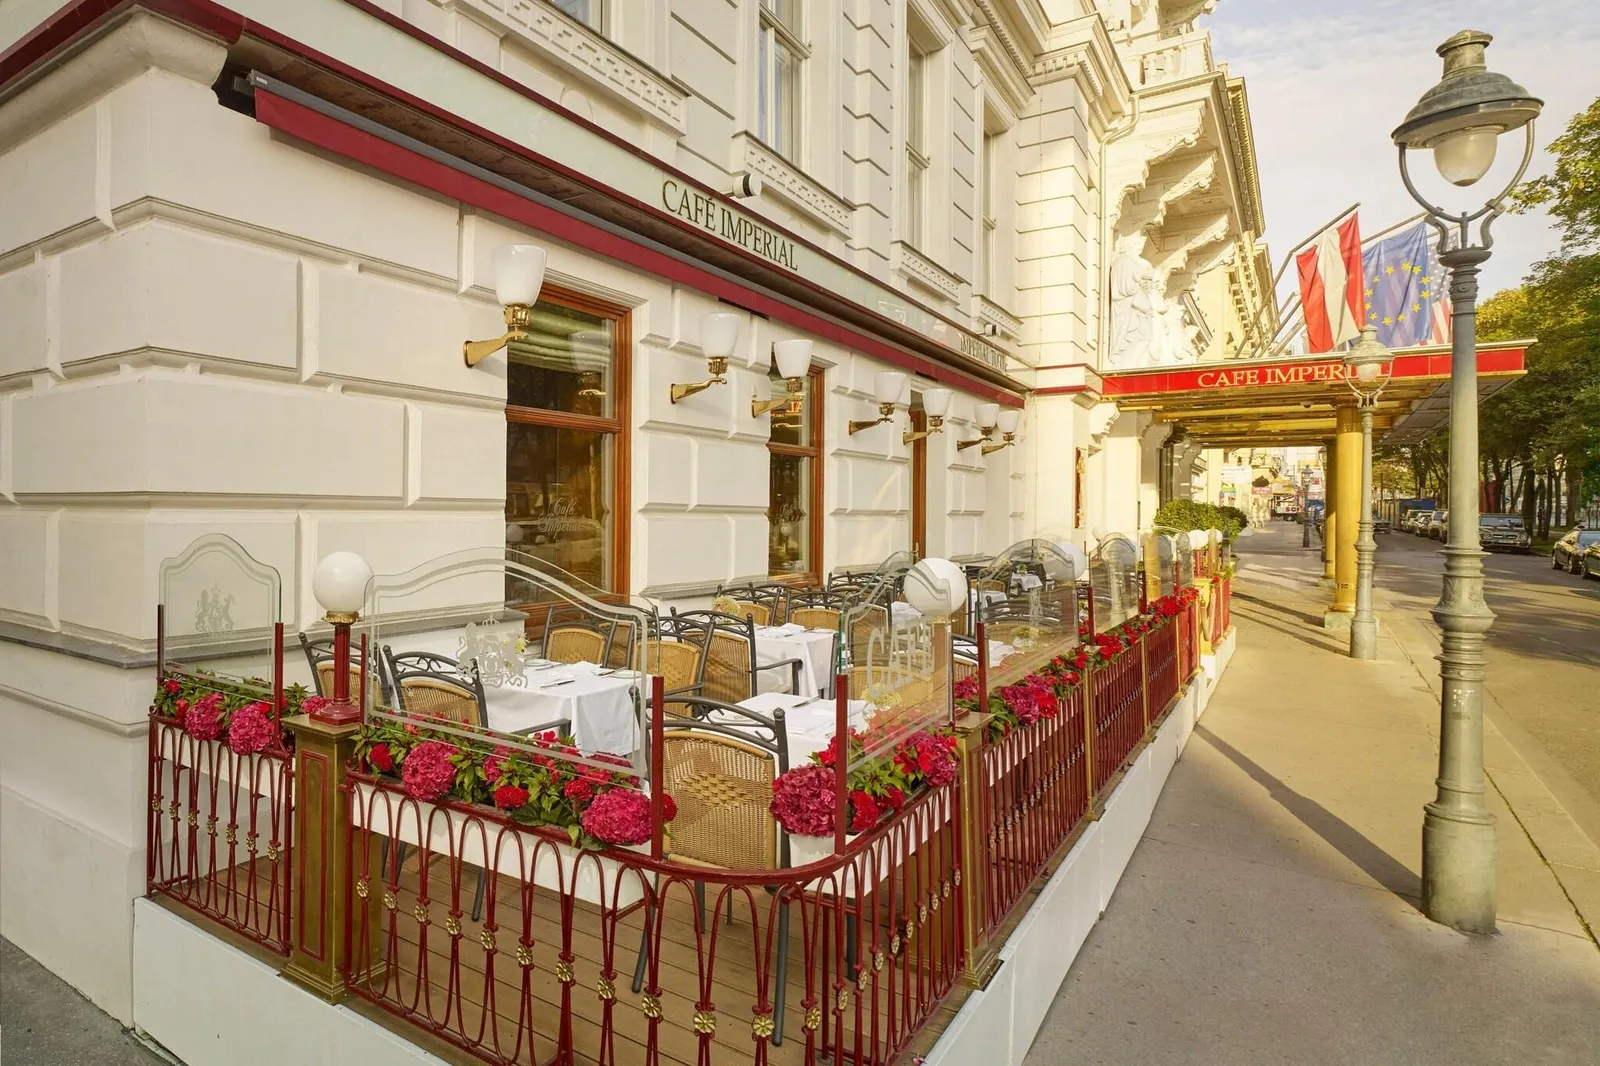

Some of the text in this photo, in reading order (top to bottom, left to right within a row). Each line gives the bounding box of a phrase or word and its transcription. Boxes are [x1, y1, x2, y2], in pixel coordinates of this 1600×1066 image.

[662, 180, 799, 272] CAFÉ IMPERIAL
[1197, 363, 1389, 388] CAFE IMPERIL
[553, 497, 577, 519] Café
[537, 512, 582, 540] Imperial
